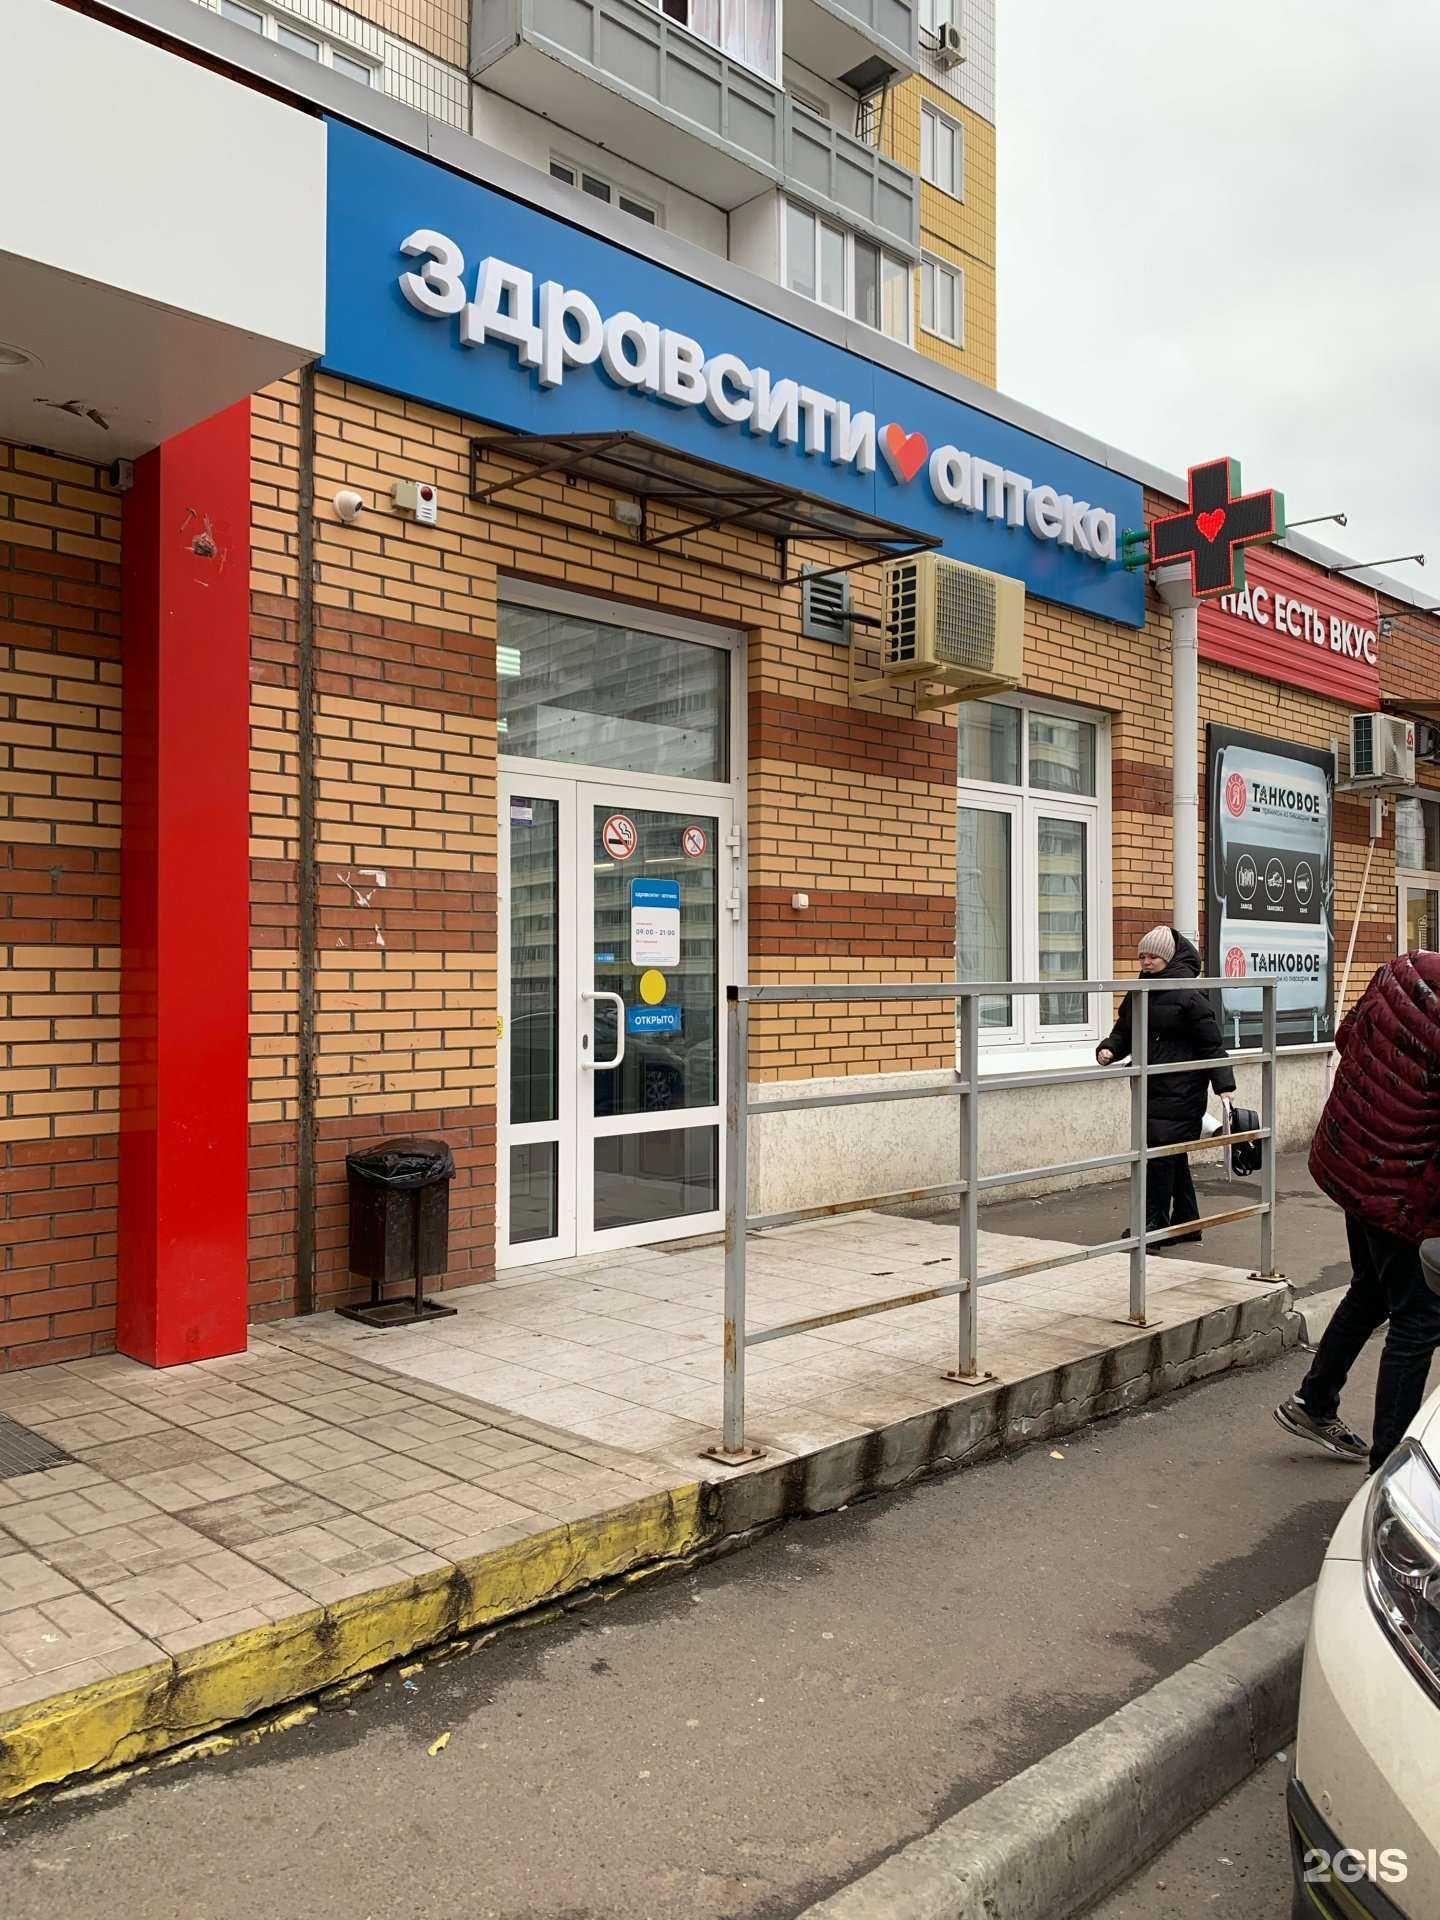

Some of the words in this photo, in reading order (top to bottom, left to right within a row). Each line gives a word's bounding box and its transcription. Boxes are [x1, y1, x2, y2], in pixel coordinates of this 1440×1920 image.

[399, 229, 876, 474] здравсити
[929, 444, 1117, 561] аптека
[1274, 593, 1326, 645] ЕСТЬ
[1329, 616, 1378, 665] ВКУС
[1252, 782, 1320, 814] ТАНКОВОЕ
[1250, 952, 1320, 973] ТАНКОВОЕ
[634, 1015, 675, 1026] ОТКРЫТО
